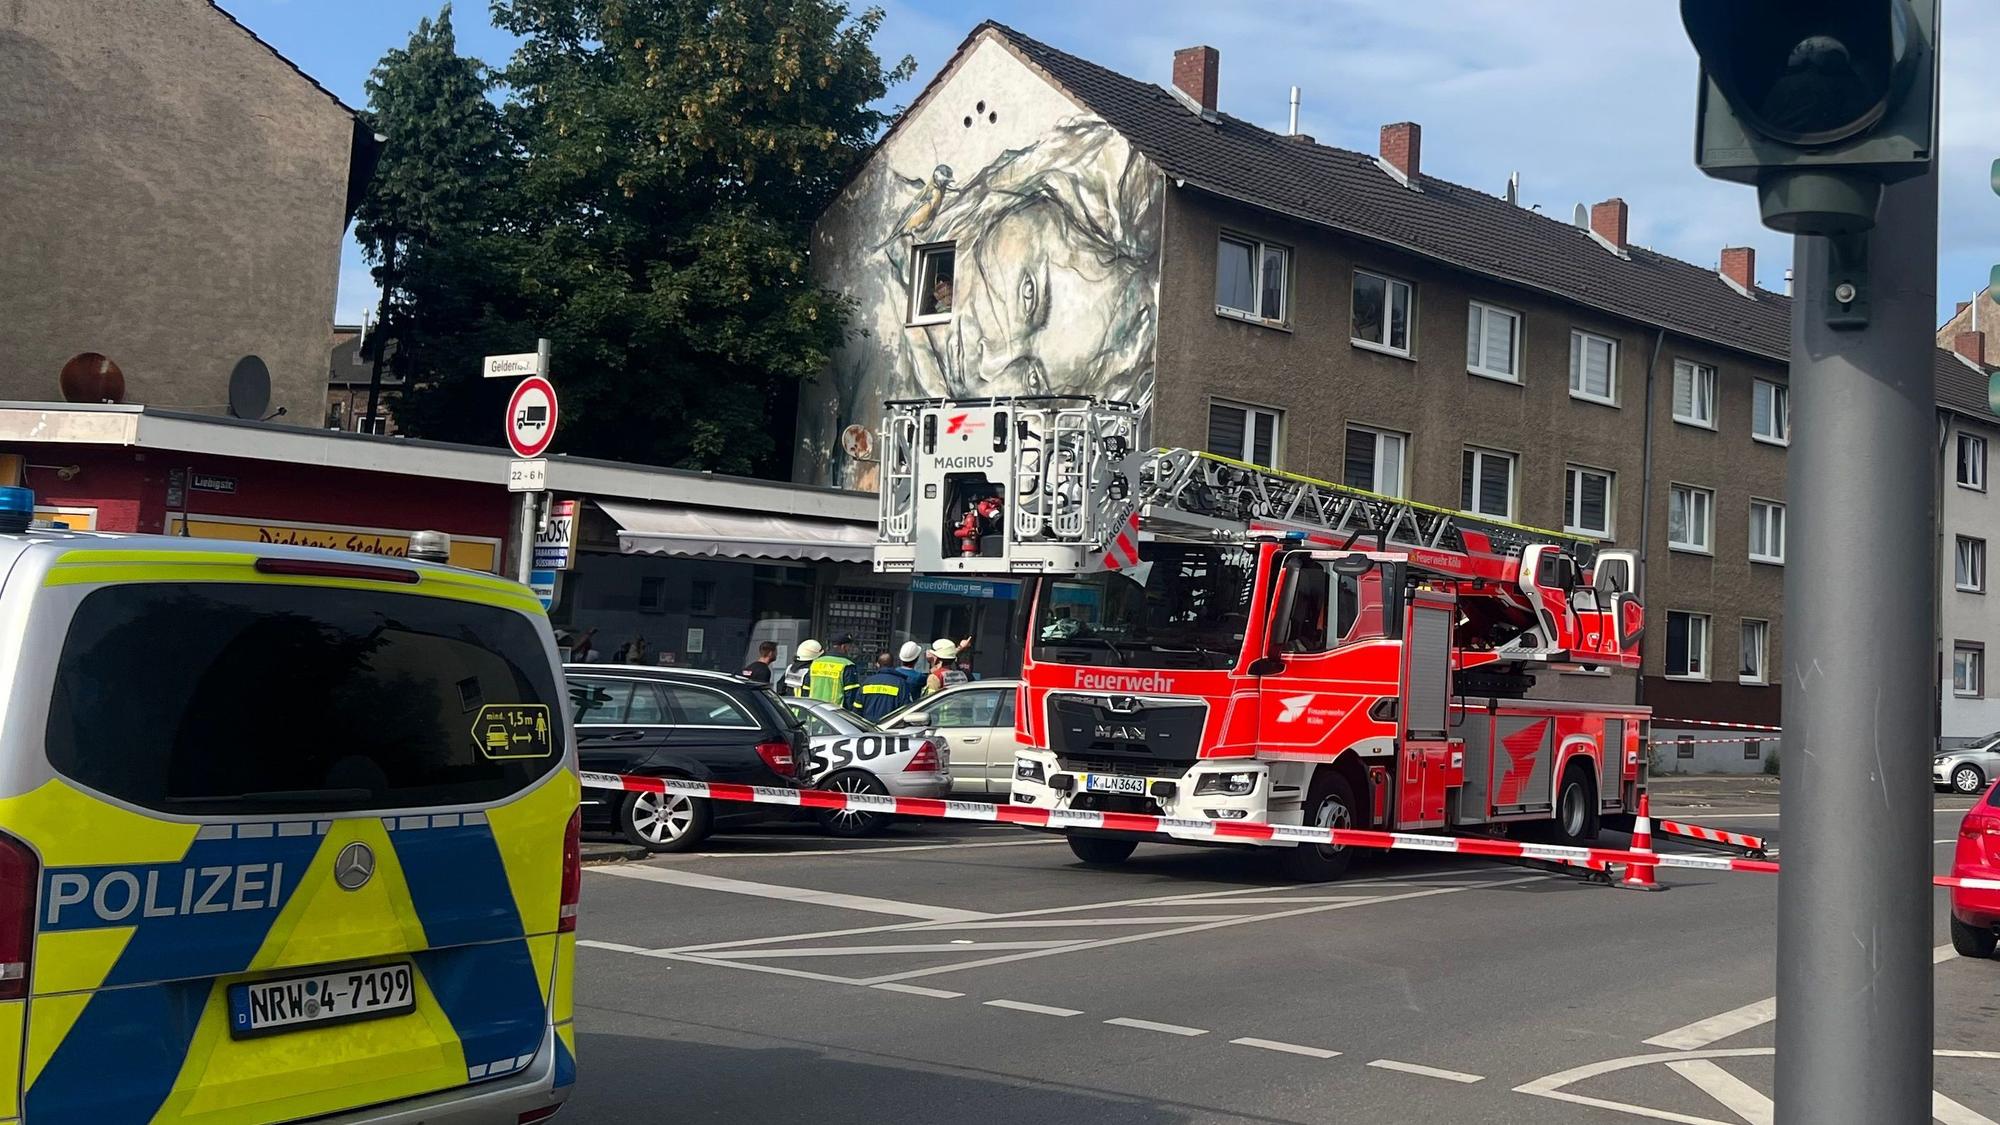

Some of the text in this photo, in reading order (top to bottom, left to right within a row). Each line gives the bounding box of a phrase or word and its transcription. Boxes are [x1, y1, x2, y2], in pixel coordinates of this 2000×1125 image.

[491, 360, 530, 372] Geldern
[934, 456, 993, 468] MAGIRUS
[511, 471, 522, 480] 22
[530, 470, 535, 480] 6
[537, 471, 543, 480] h
[1103, 500, 1135, 551] MAGIRUS
[912, 579, 969, 594] Neueröffnung
[1074, 669, 1175, 693] Feuerwehr
[486, 711, 533, 727] mind. 1,5 m
[1094, 723, 1147, 740] MAN
[1093, 777, 1100, 788] K
[47, 862, 284, 925] POLIZEI
[250, 984, 302, 1024] NRW
[239, 1013, 247, 1024] D
